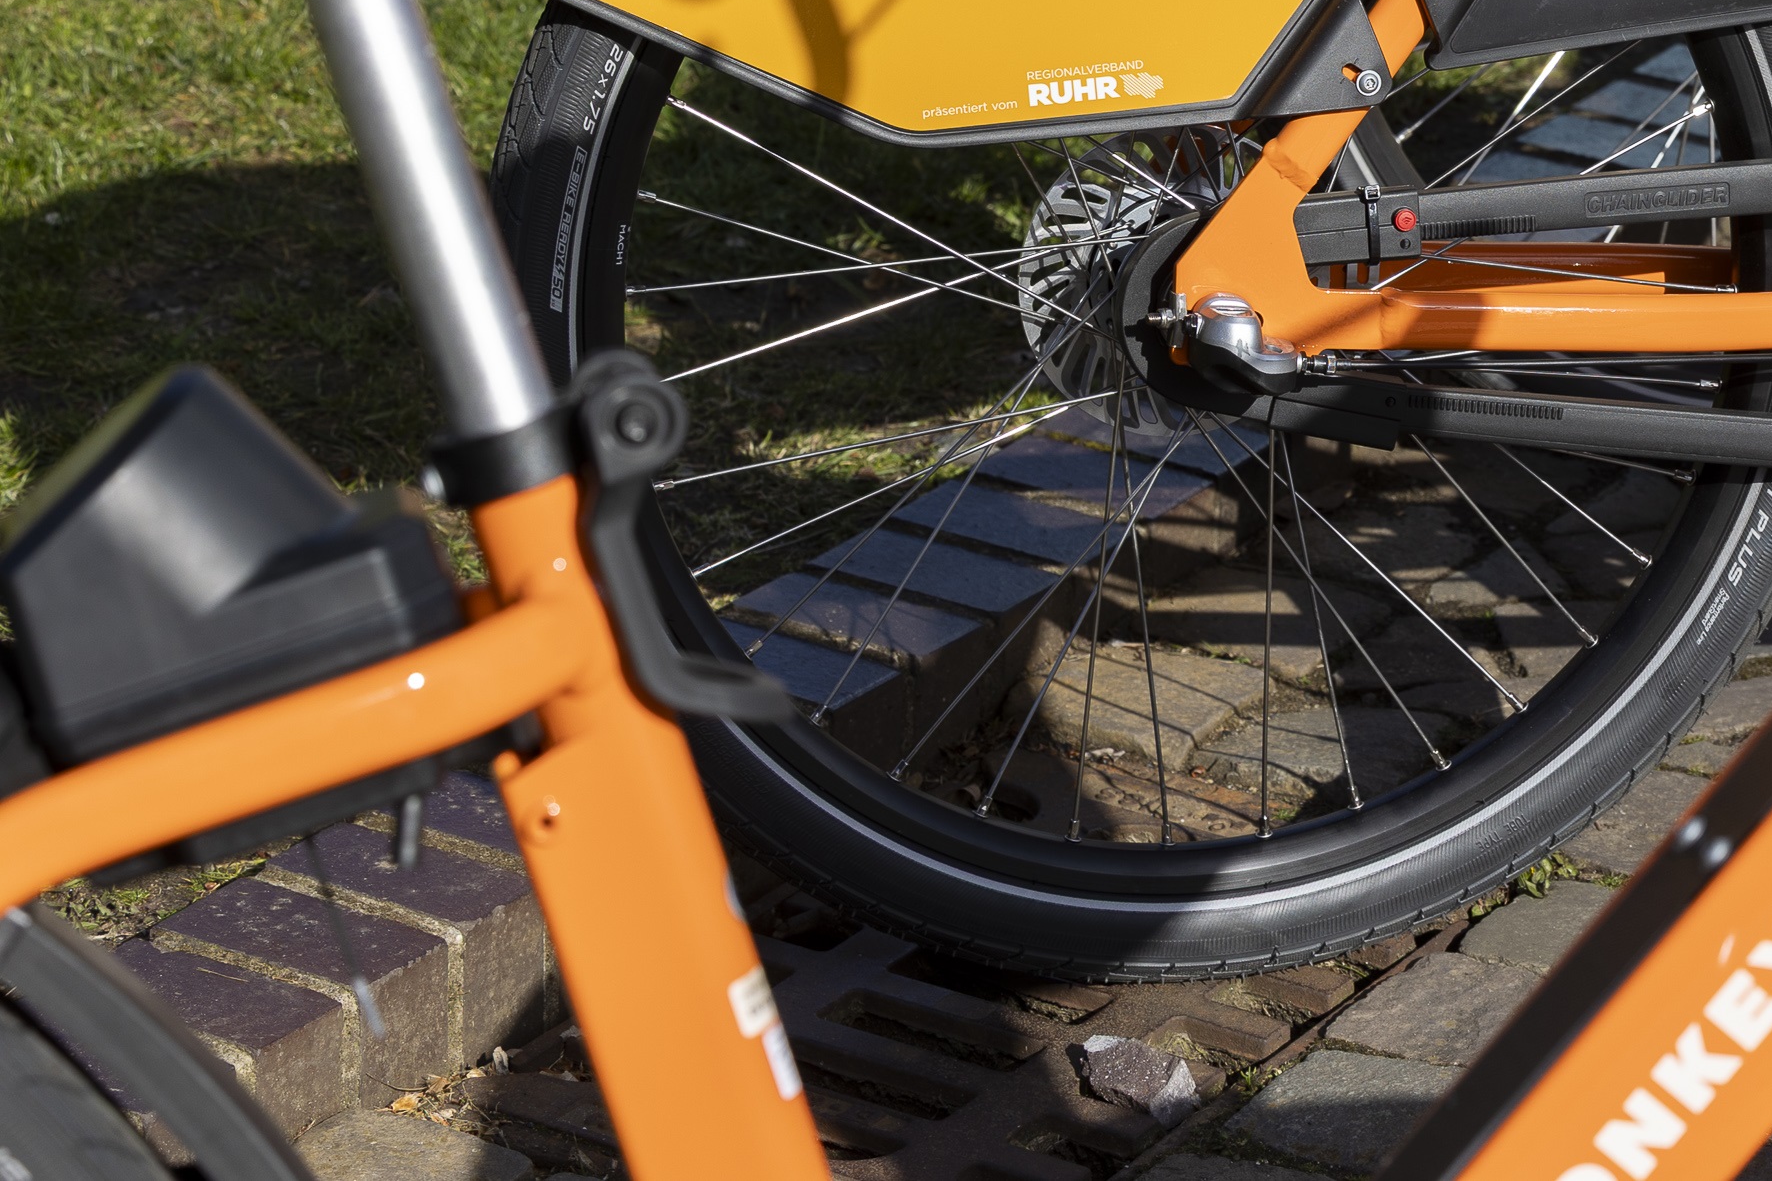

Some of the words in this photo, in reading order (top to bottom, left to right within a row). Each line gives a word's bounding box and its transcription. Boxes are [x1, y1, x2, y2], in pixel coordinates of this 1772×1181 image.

[1026, 59, 1144, 81] REGIONALVERBAND
[1027, 75, 1121, 107] RUHR
[922, 102, 988, 120] präsentiert
[991, 100, 1018, 112] vom
[566, 151, 585, 208] E-BIKE
[1586, 186, 1729, 214] CHAINGLIDER
[555, 211, 572, 263] READY
[615, 224, 627, 266] MACH1
[1728, 509, 1770, 587] PLUS
